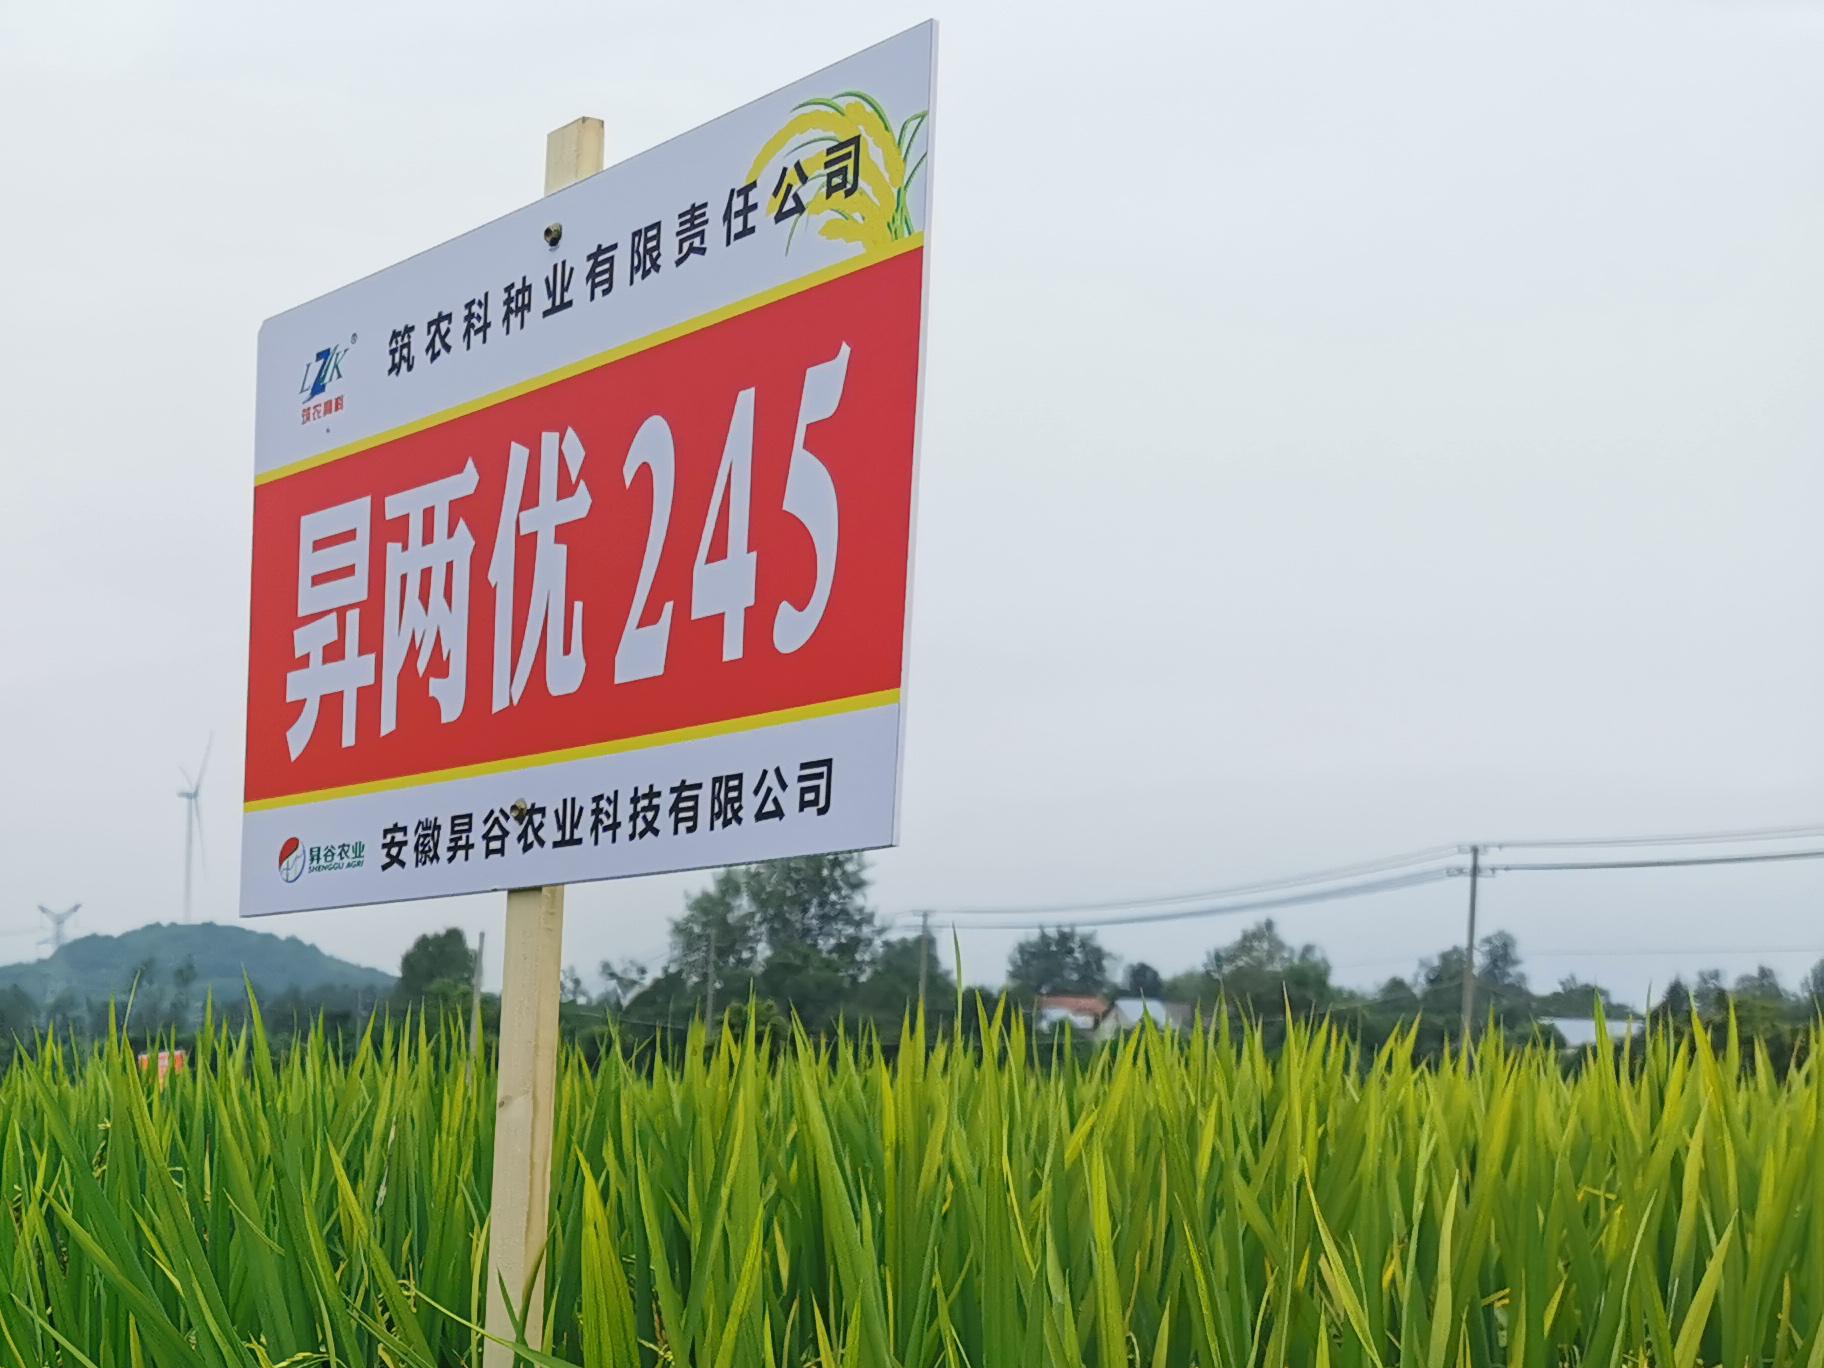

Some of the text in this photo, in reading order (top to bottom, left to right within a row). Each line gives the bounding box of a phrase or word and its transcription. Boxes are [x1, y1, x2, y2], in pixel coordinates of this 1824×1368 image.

[387, 134, 862, 377] 筑农科种业有限责任公司
[309, 841, 365, 863] 昇谷农业
[379, 757, 835, 874] 安徽昇谷农业科技有限公司
